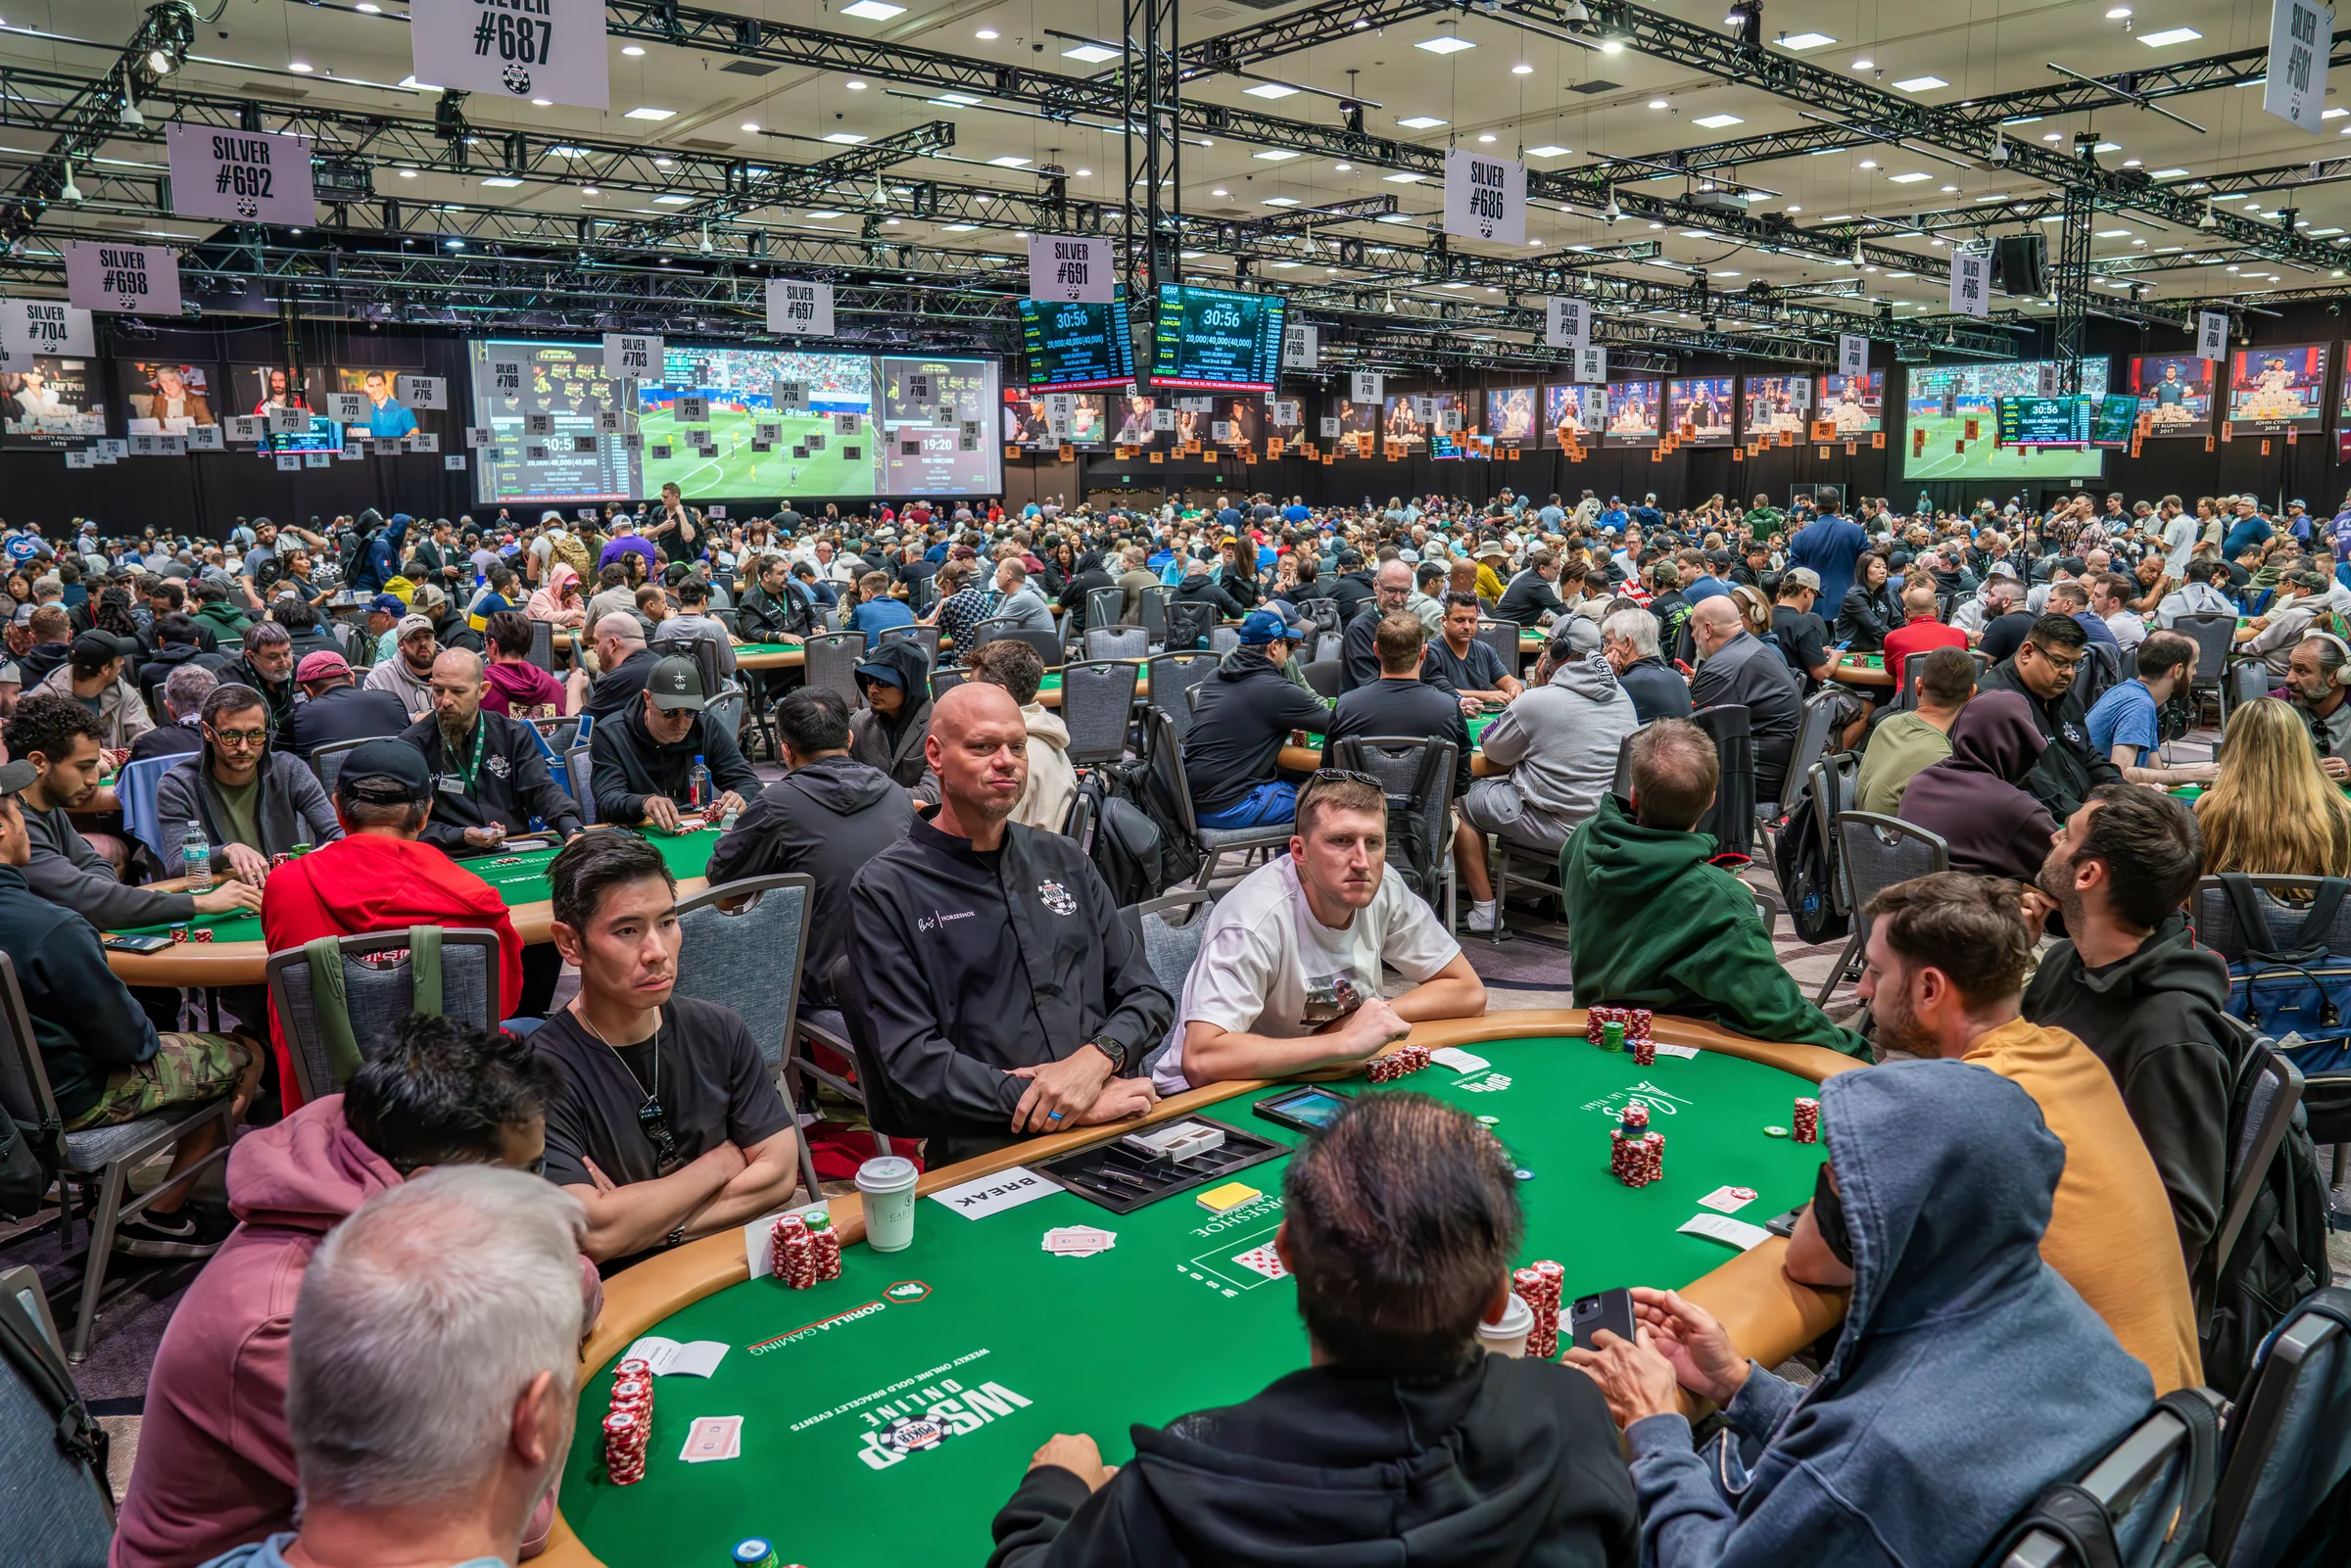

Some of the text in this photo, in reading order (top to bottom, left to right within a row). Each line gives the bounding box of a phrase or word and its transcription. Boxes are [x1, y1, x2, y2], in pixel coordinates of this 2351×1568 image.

[2291, 2, 2316, 47] SILVER
[474, 11, 552, 65] #687
[2286, 44, 2312, 93] #681
[213, 135, 270, 165] SILVER
[216, 164, 273, 199] #692
[1471, 161, 1505, 189] SILVER
[1469, 188, 1504, 219] #686
[100, 249, 145, 269] SILVER
[1055, 242, 1088, 261] SILVER
[1057, 262, 1088, 284] #691
[1963, 260, 1979, 277] SILVER
[103, 270, 148, 295] #698
[1962, 278, 1979, 300] #685
[787, 285, 814, 302] SILVER
[26, 305, 65, 321] SILVER
[788, 302, 814, 320] #697
[1204, 309, 1240, 327] 30:56
[1561, 303, 1578, 317] SILVER
[1056, 310, 1087, 328] 30:56
[1560, 318, 1577, 335] #690
[2208, 317, 2220, 331] SILVER
[28, 321, 69, 341] #704
[1286, 328, 1304, 340] SILVER
[622, 339, 647, 351] SILVER
[1286, 341, 1305, 356] #696
[1848, 340, 1860, 351] SILVER
[623, 353, 647, 366] #703
[1585, 351, 1597, 359] SILVER
[496, 363, 518, 374] SILVER
[411, 379, 432, 389] SILVER
[497, 375, 519, 388] #709
[1362, 374, 1373, 384] SILVER
[412, 389, 432, 401] #715
[784, 392, 798, 402] #714
[911, 386, 927, 397] #708
[1128, 386, 1136, 396] 45
[1362, 385, 1373, 396] #701
[340, 395, 359, 405] SILVER
[282, 409, 298, 418] SILVER
[341, 404, 360, 415] #721
[2032, 405, 2057, 414] 30:56
[282, 416, 299, 427] #727
[543, 439, 574, 451] 30:5
[923, 439, 952, 450] 19:20
[919, 911, 976, 932] Paris HORSESHOE
[1460, 1073, 1512, 1093] COPAG
[1580, 1091, 1626, 1111] LAS VEGAS
[954, 1178, 1036, 1207] BREAK
[749, 1303, 886, 1355] GORILLA GAMING
[790, 1348, 989, 1432] WEEKLY ONLINE GOLD BRACELET EVENTS
[859, 1379, 963, 1427] ONLINE
[858, 1381, 1032, 1470] WSOP
[897, 1424, 936, 1444] POKER
